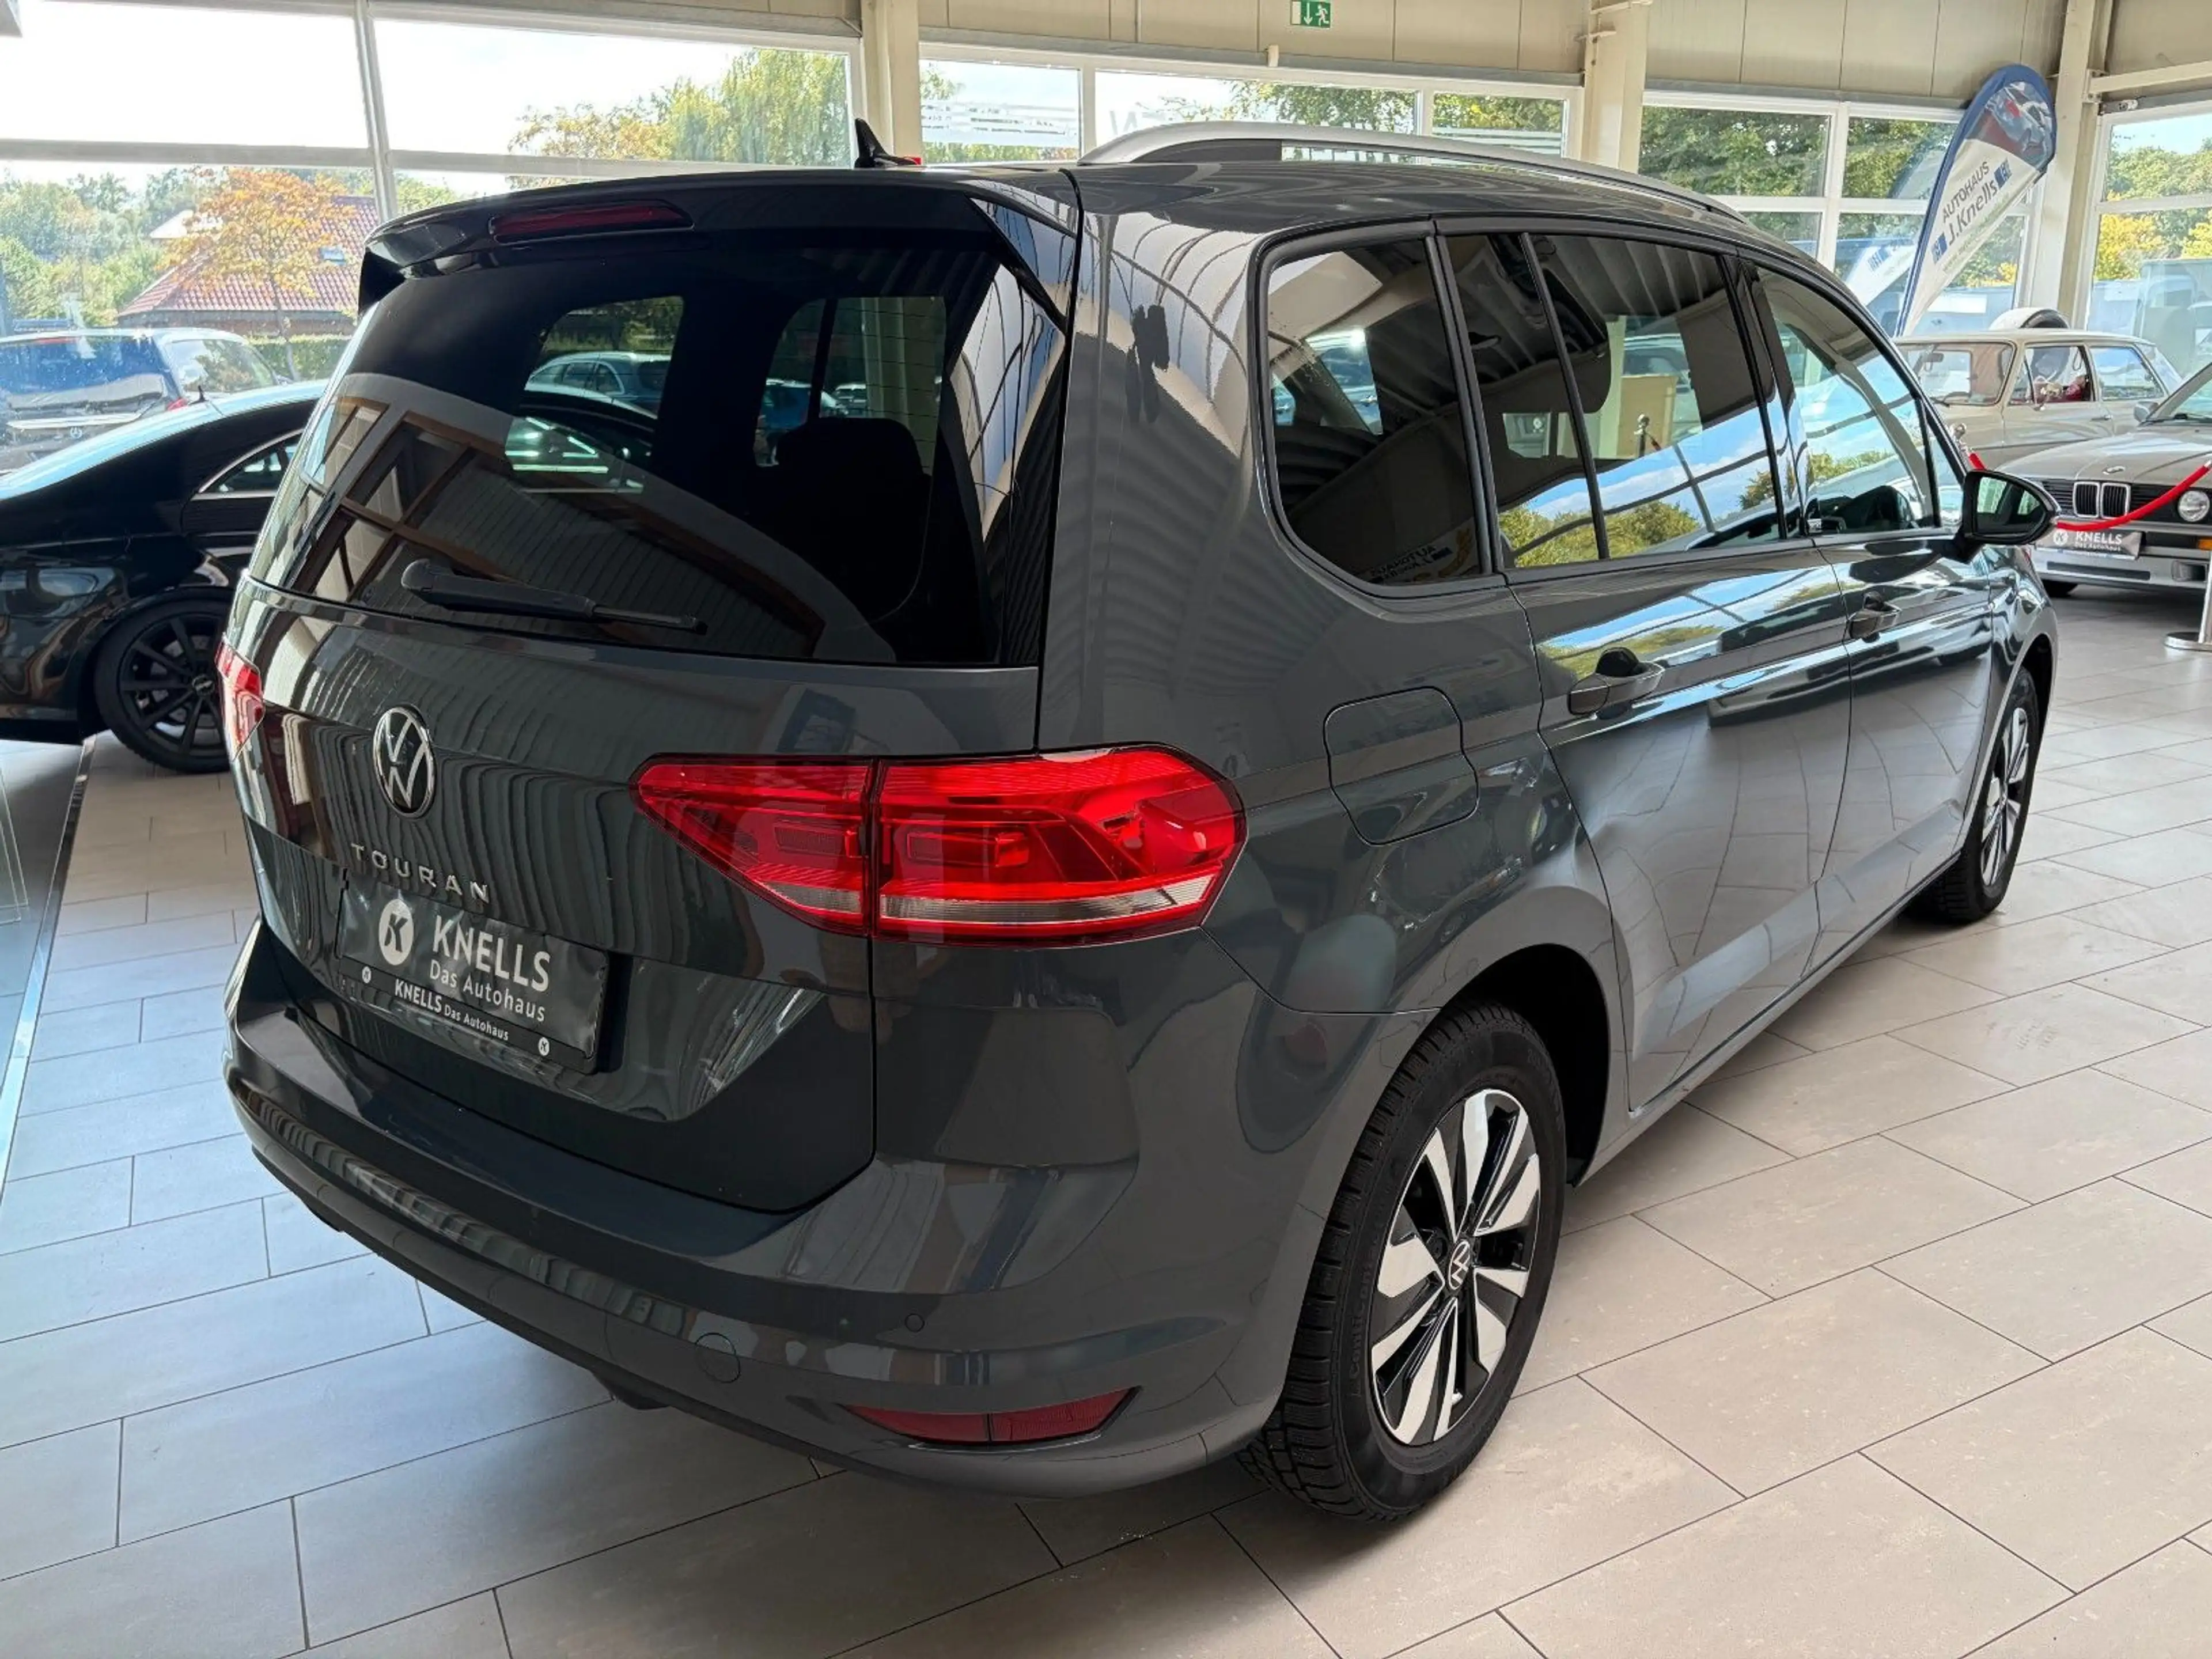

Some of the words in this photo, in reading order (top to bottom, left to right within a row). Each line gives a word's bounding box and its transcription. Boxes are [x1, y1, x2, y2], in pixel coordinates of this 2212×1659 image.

[1942, 161, 1990, 224] AUTOHAUS
[1949, 180, 1998, 246] J.Knells
[2076, 531, 2122, 545] KNELLS
[351, 843, 488, 903] TOURAN
[433, 915, 551, 992] KNELLS
[395, 979, 442, 1012] KNELLS
[444, 1004, 461, 1021] Das
[463, 1013, 509, 1041] Autohaus
[430, 959, 457, 988] Das
[463, 974, 546, 1022] Autohaus
